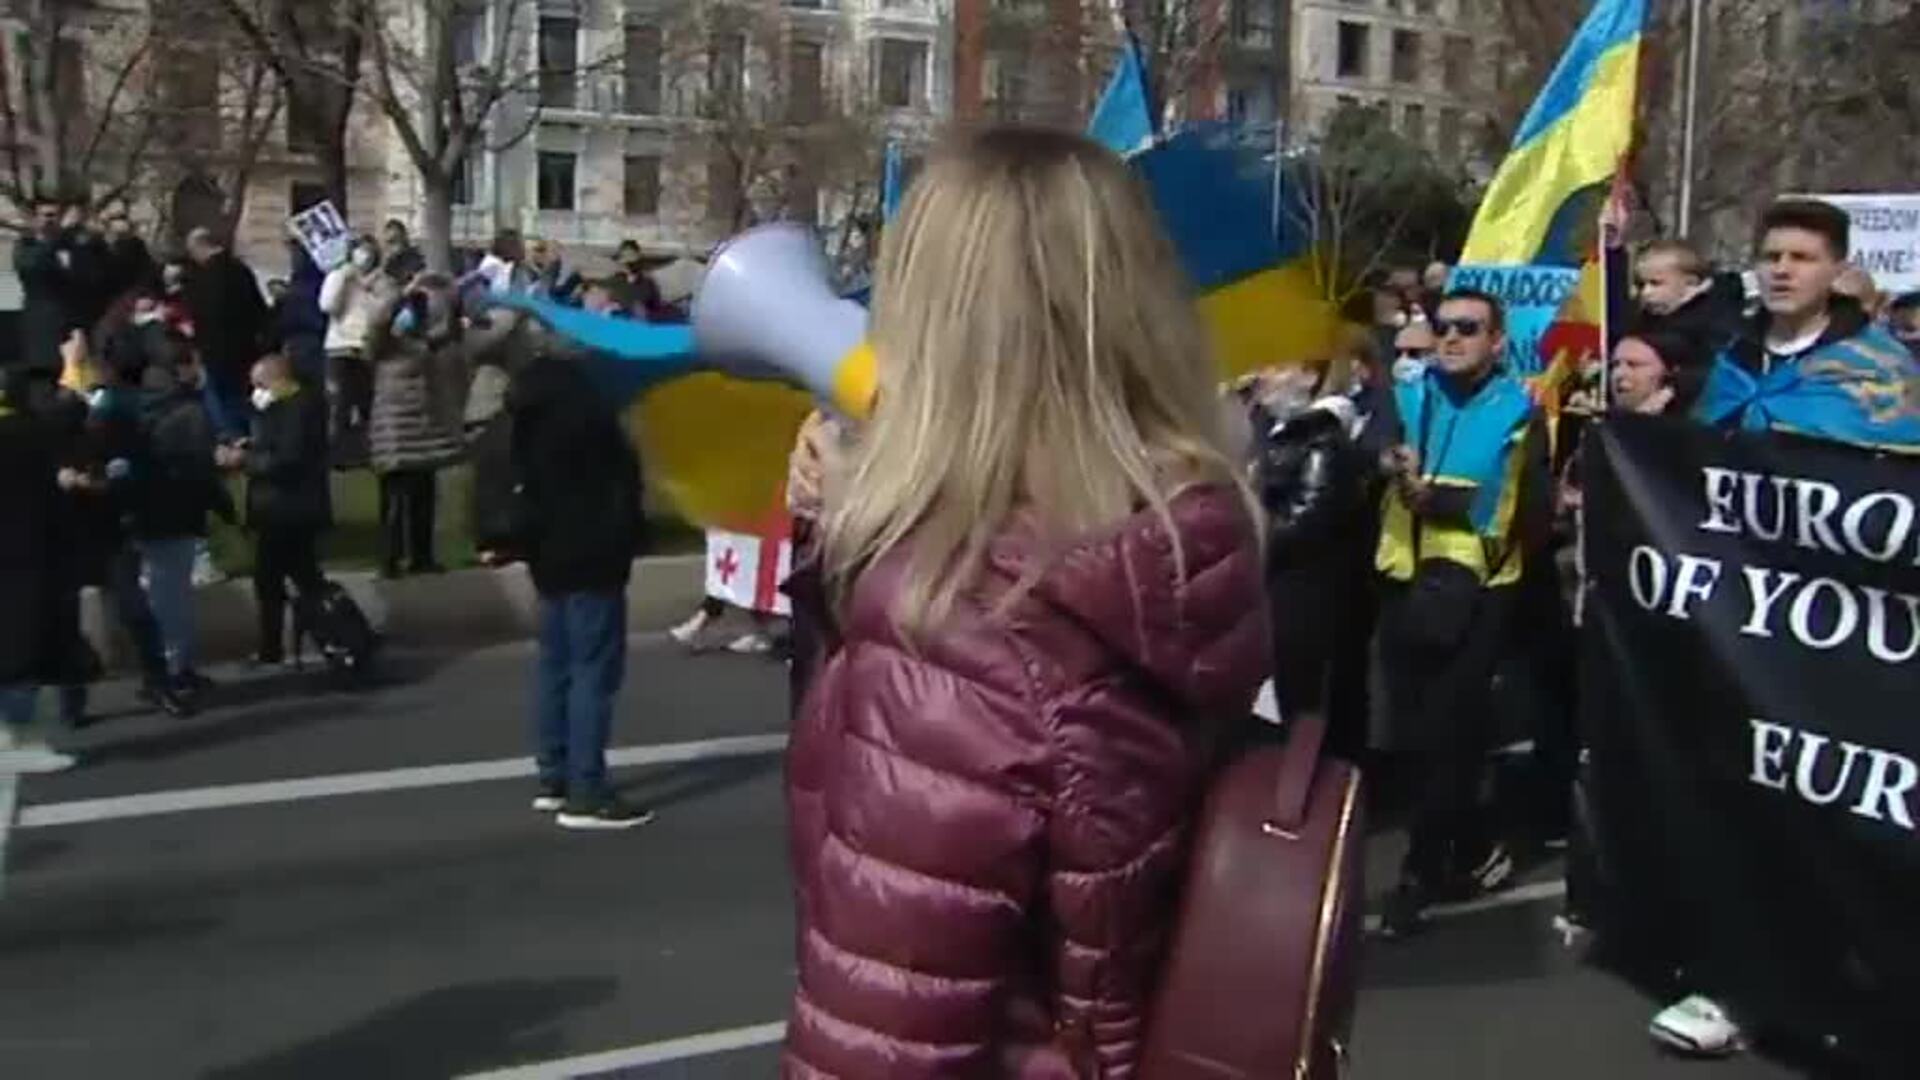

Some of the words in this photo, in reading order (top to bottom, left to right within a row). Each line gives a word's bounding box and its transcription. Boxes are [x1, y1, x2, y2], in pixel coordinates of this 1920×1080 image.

[1700, 467, 1920, 566] EURO
[1630, 545, 1721, 619] OF
[1740, 564, 1920, 663] YOU
[1749, 719, 1916, 830] EUR
